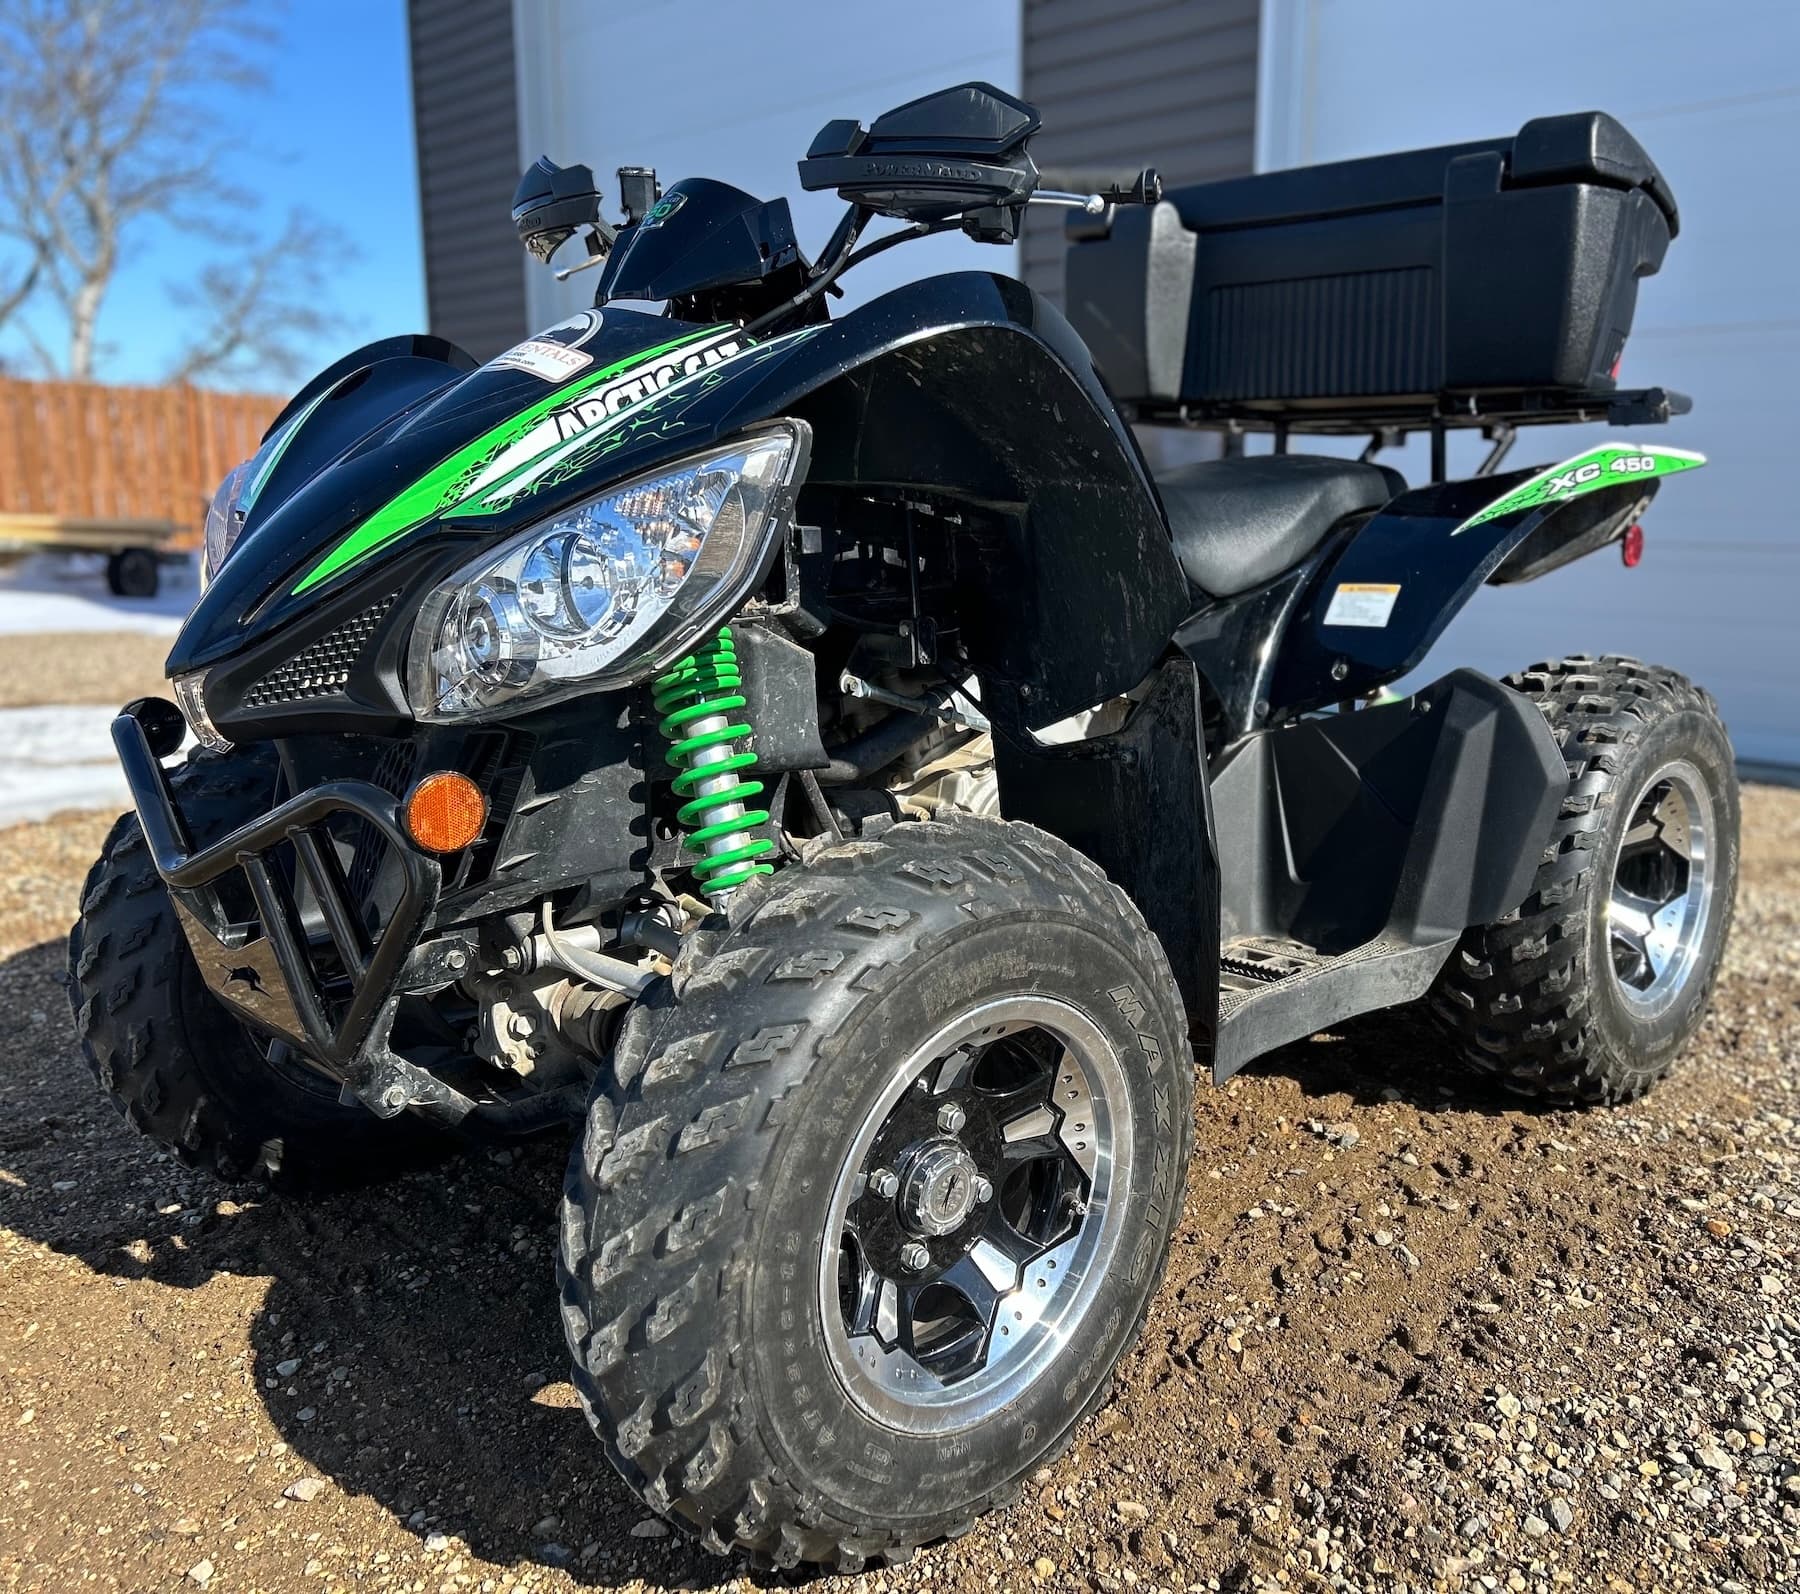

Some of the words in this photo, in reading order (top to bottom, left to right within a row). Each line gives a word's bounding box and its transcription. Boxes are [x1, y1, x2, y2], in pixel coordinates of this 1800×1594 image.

[559, 362, 678, 442] ARCTIC
[1548, 463, 1602, 496] XC
[1610, 456, 1655, 473] 450
[1106, 984, 1172, 1286] MAXXIS
